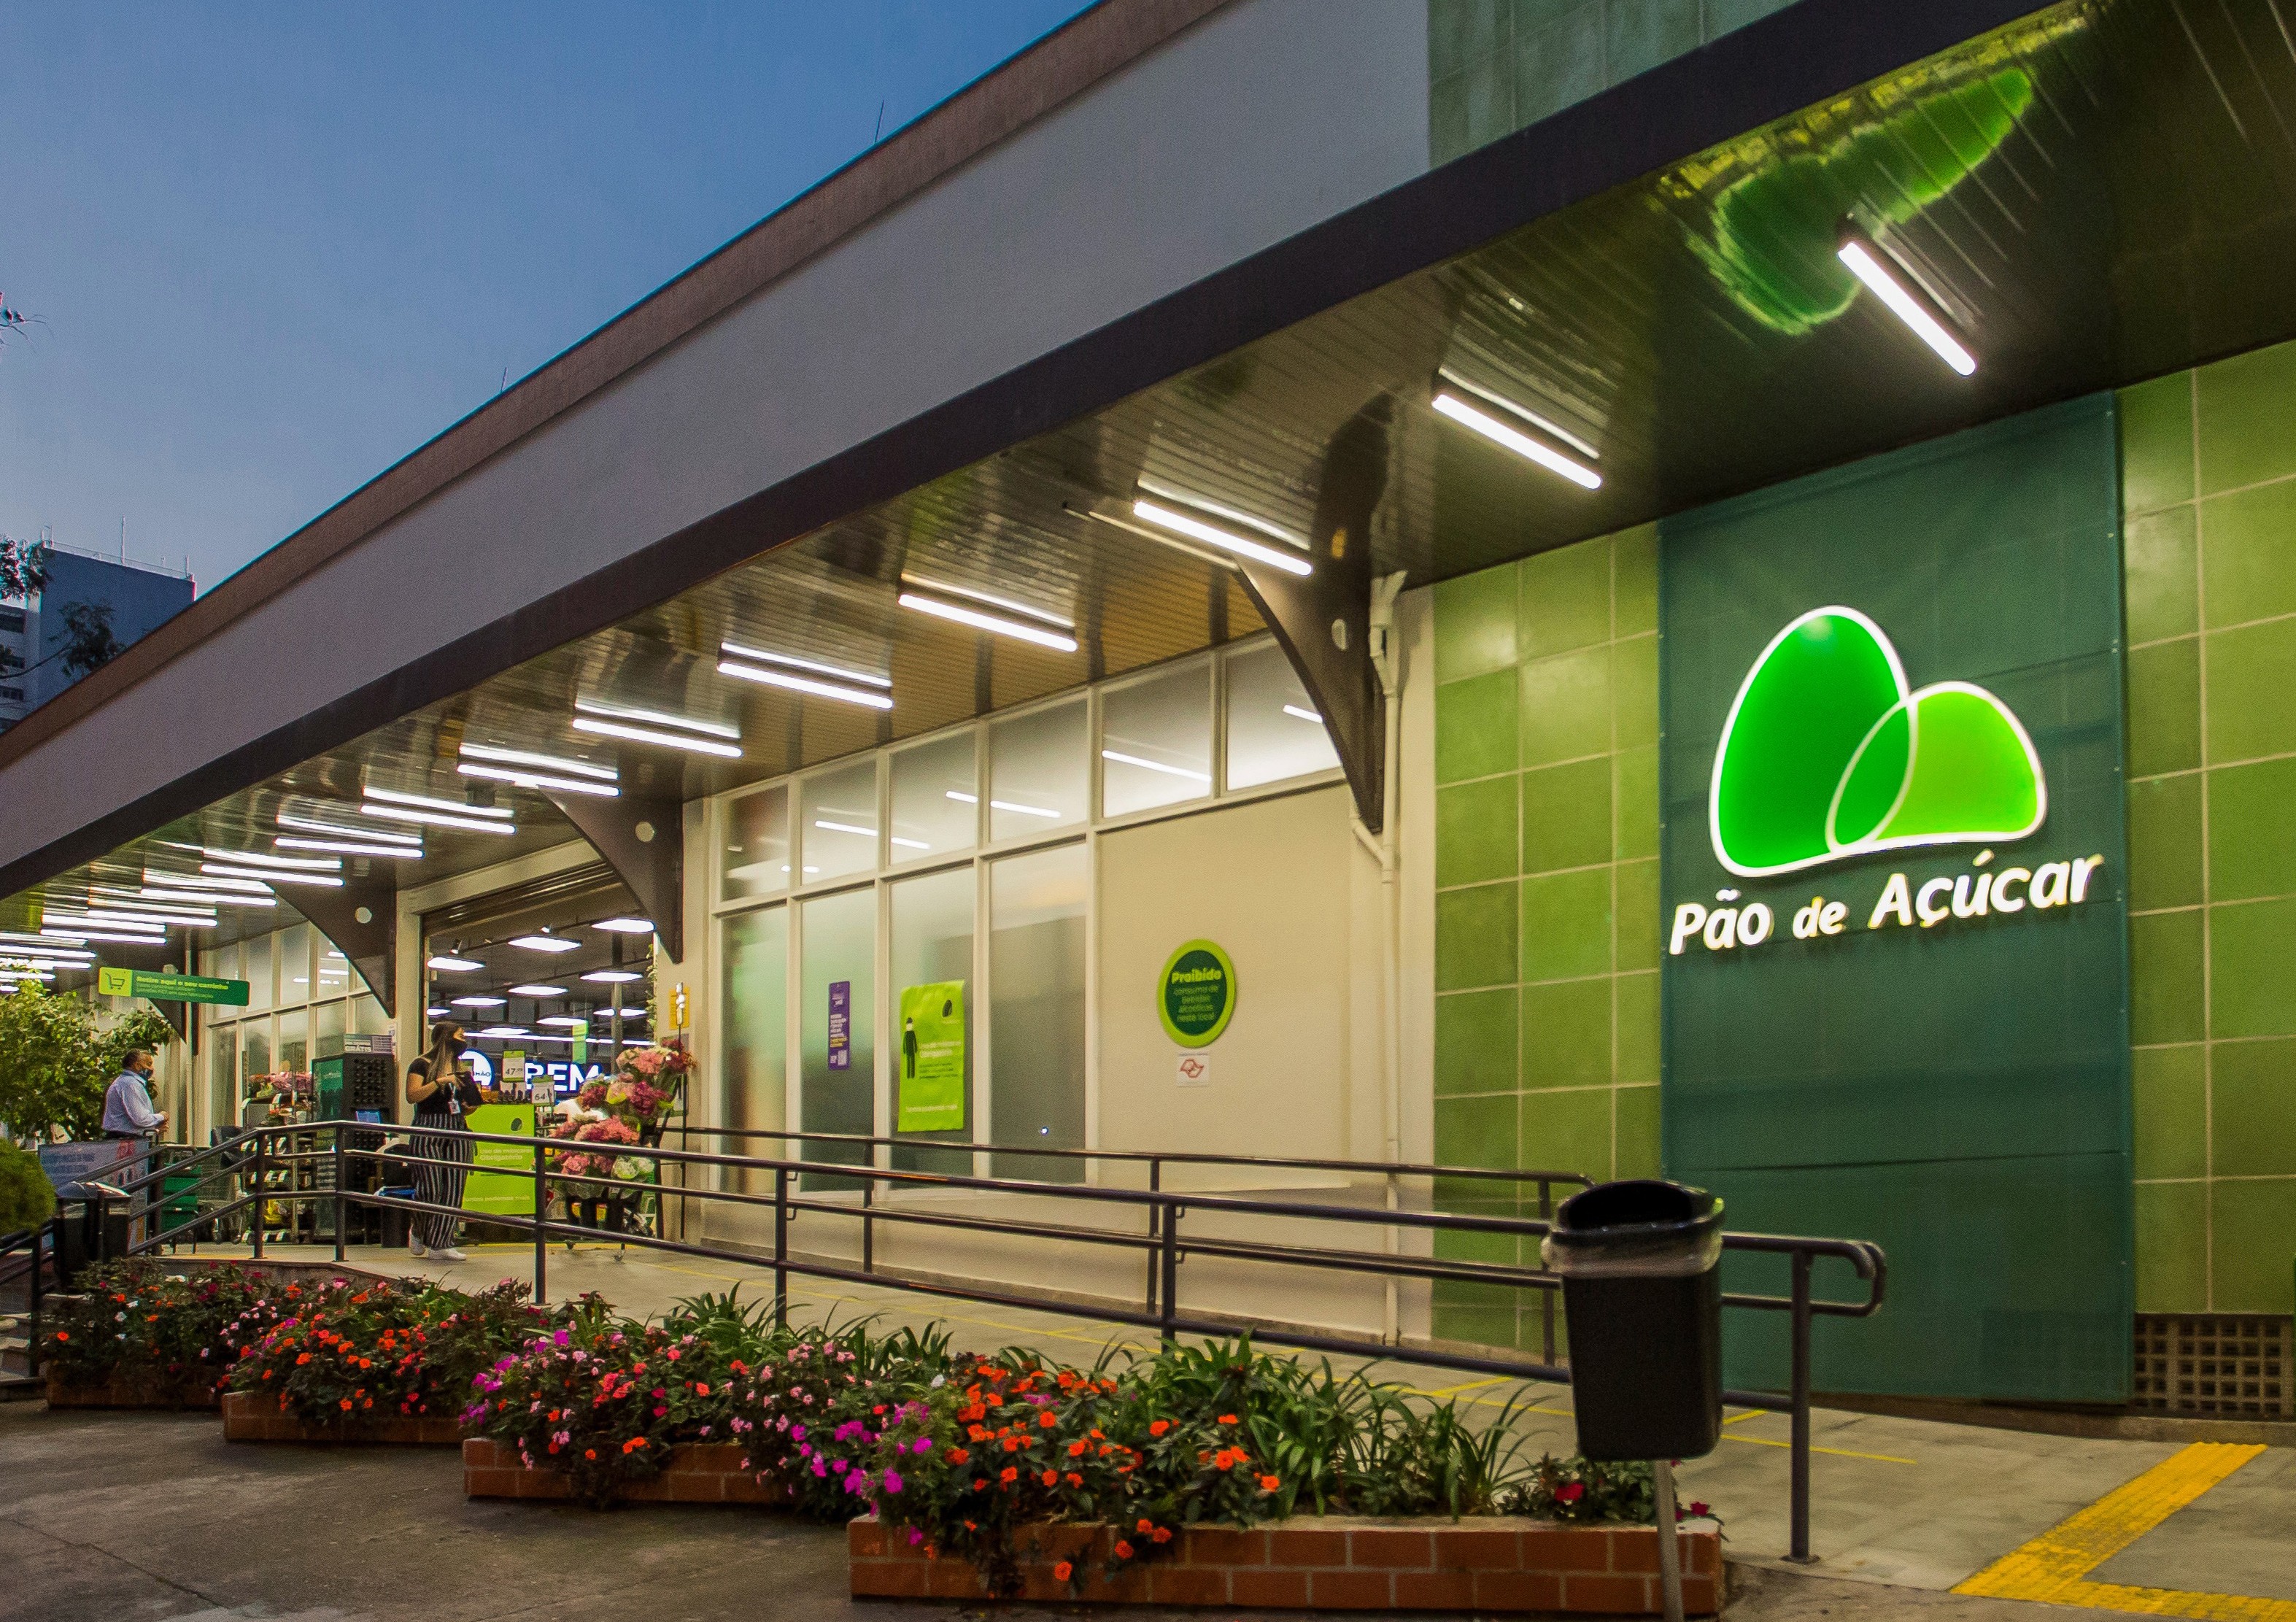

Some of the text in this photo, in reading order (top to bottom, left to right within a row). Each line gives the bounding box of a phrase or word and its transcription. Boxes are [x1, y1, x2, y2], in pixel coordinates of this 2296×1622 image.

[1669, 848, 2105, 955] Pão de Açúcar
[1171, 968, 1222, 984] Proibido
